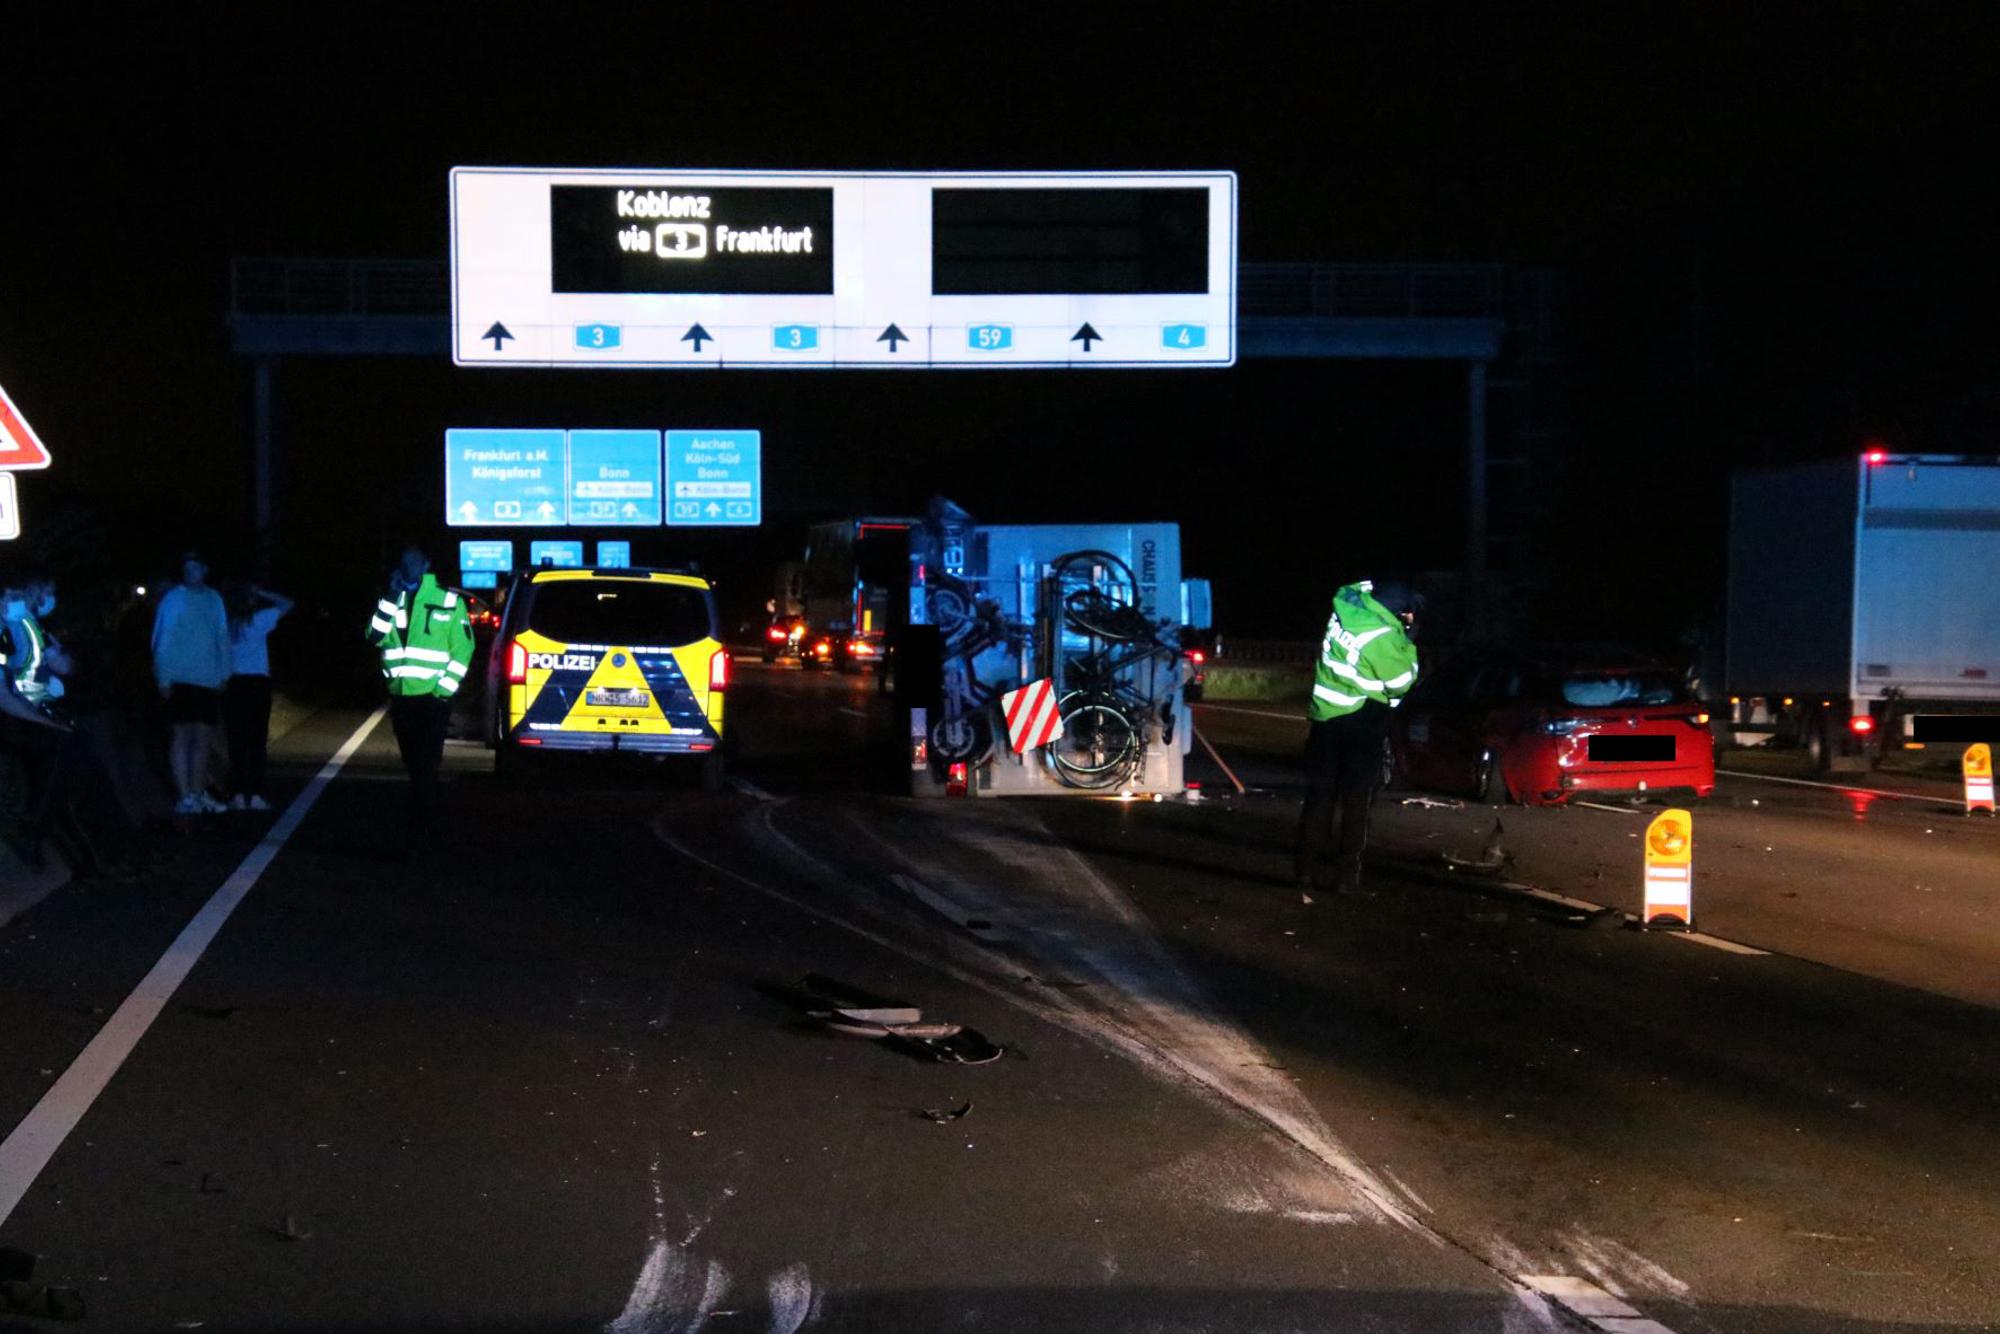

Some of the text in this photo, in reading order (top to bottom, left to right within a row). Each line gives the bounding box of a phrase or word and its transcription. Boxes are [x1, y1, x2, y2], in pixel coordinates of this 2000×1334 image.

[617, 190, 711, 219] Koblenz
[618, 225, 650, 253] via
[716, 224, 813, 253] Frankfurt
[593, 327, 605, 346] 3
[791, 329, 802, 348] 3
[978, 327, 1002, 348] 59
[1178, 329, 1190, 348] 4
[691, 438, 735, 450] Aachen
[463, 448, 521, 461] Frankfurt
[685, 452, 741, 464] Köln-Süd
[472, 465, 541, 482] Königsforst
[599, 466, 631, 479] Bonn
[697, 467, 729, 479] Bonn
[528, 654, 596, 670] POLIZEI
